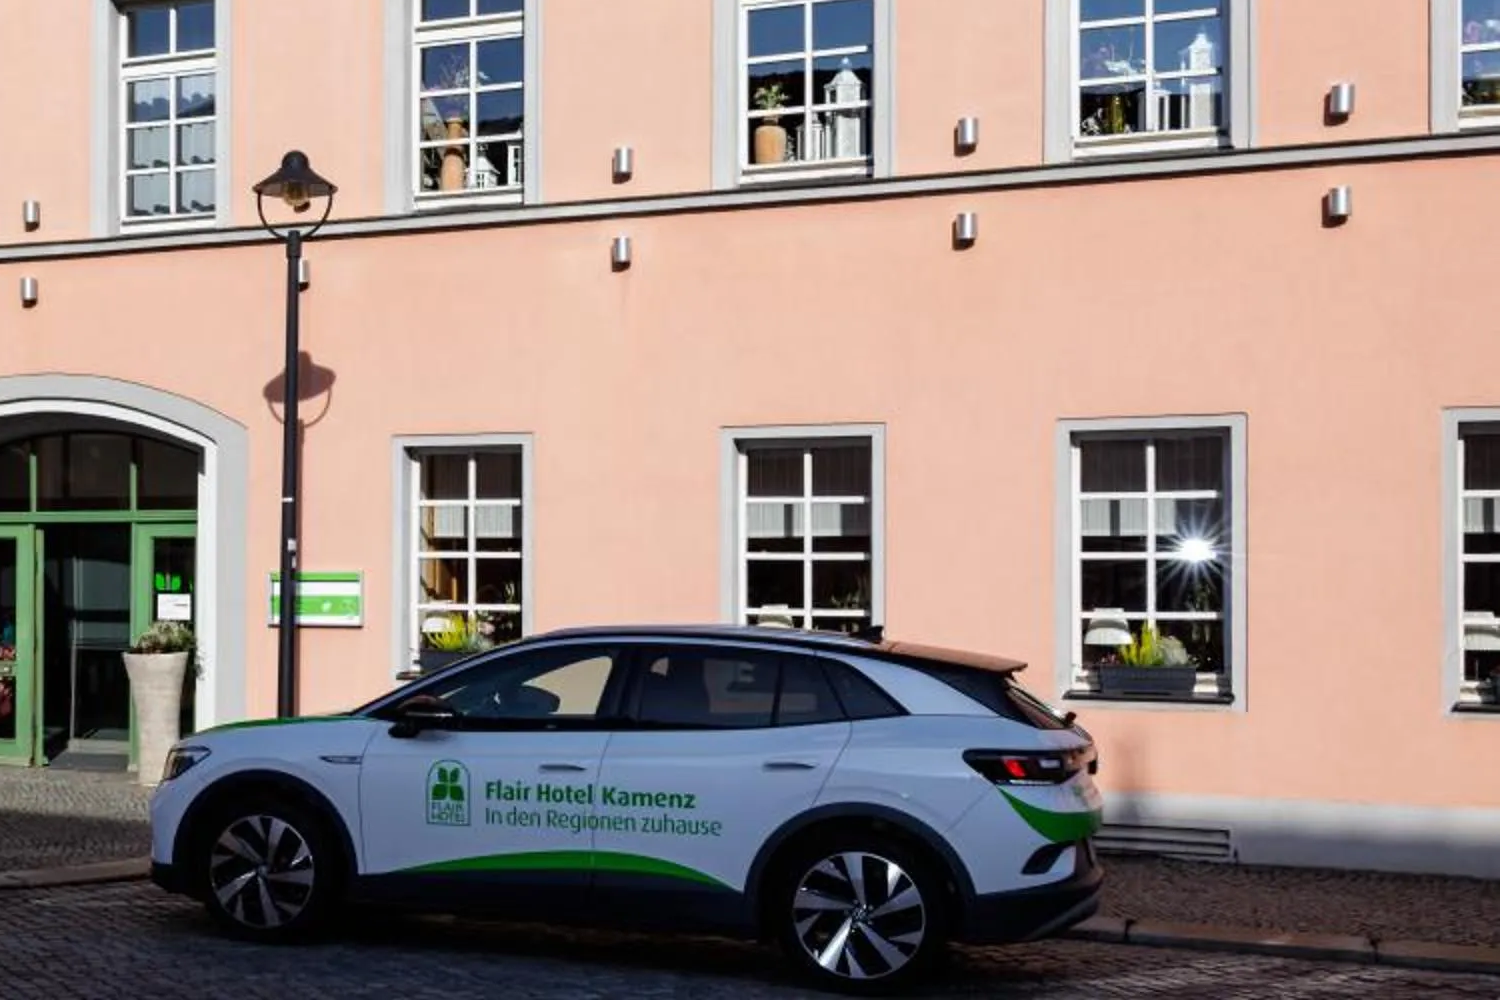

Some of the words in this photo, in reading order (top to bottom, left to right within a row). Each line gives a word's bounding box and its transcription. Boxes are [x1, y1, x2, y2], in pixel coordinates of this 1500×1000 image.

[485, 779, 531, 801] Flair
[537, 782, 593, 805] Hotel
[602, 785, 696, 809] Kamenz
[485, 807, 502, 825] In
[506, 807, 540, 827] den
[547, 809, 637, 834] Regionen
[640, 814, 723, 837] zuhause
